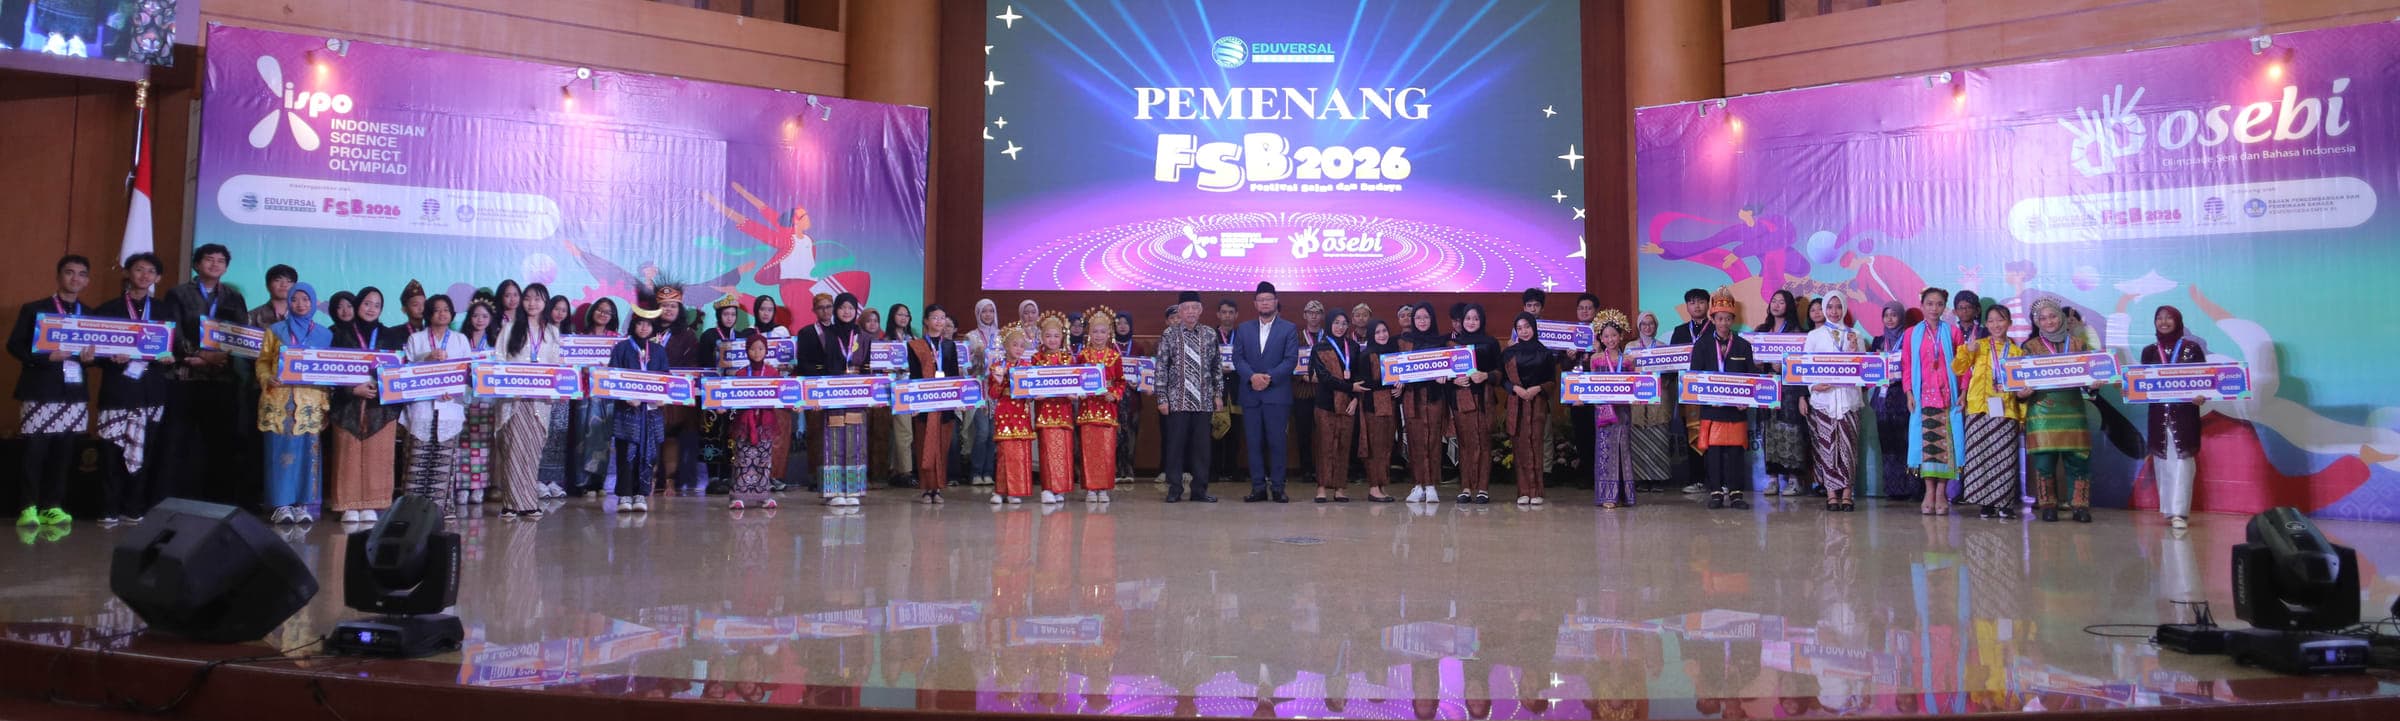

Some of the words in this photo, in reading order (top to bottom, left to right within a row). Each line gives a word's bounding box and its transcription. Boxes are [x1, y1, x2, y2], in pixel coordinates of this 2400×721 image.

[1252, 43, 1335, 54] EDUVERSAL
[284, 82, 353, 118] ispo
[1133, 87, 1432, 120] PEMENANG
[2158, 78, 2350, 150] osebi
[331, 118, 425, 137] INDONESIAN
[330, 132, 398, 148] SCIENCE
[330, 146, 402, 162] PROJECT
[2216, 154, 2238, 163] Seni
[2240, 151, 2260, 161] dan
[2262, 149, 2300, 159] Bahasa
[2302, 144, 2356, 156] Indonesia
[329, 159, 407, 175] OLYMPIAD
[1155, 132, 1293, 192] FSB
[1294, 146, 1411, 180] 2026
[264, 197, 316, 208] EDUVERSAL
[322, 197, 363, 217] FSB
[366, 203, 401, 217] 2026
[1321, 231, 1384, 252] osebi
[51, 331, 68, 342] Rp
[72, 332, 135, 344] 2.000.000
[1539, 332, 1572, 340] .000.000
[294, 362, 309, 371] Rp
[312, 363, 369, 373] 2.000.000
[1405, 360, 1449, 371] 2.000.000
[1796, 366, 1808, 374] Rp
[1810, 366, 1857, 374] 1.000.000
[2016, 370, 2030, 378] Rp
[2033, 366, 2084, 376] 1.000.000
[393, 381, 408, 390] Rp
[410, 375, 464, 387] 2.000.000
[487, 377, 501, 386] Rp
[503, 377, 551, 386] 1.000.000
[603, 380, 616, 388] Rp
[618, 381, 664, 392] 1.000.000
[1035, 378, 1078, 386] 2.000.000
[2138, 381, 2153, 390] Rp
[2156, 379, 2212, 389] 1.000.000
[715, 391, 728, 399] Rp
[730, 390, 776, 398] 1.000.000
[812, 390, 824, 398] Rp
[826, 389, 869, 397] 1.000.000
[1587, 385, 1631, 393] 1.000.000
[1691, 384, 1704, 393] Rp
[1706, 385, 1751, 395] 1.000.000
[917, 391, 958, 400] 1.000.000
